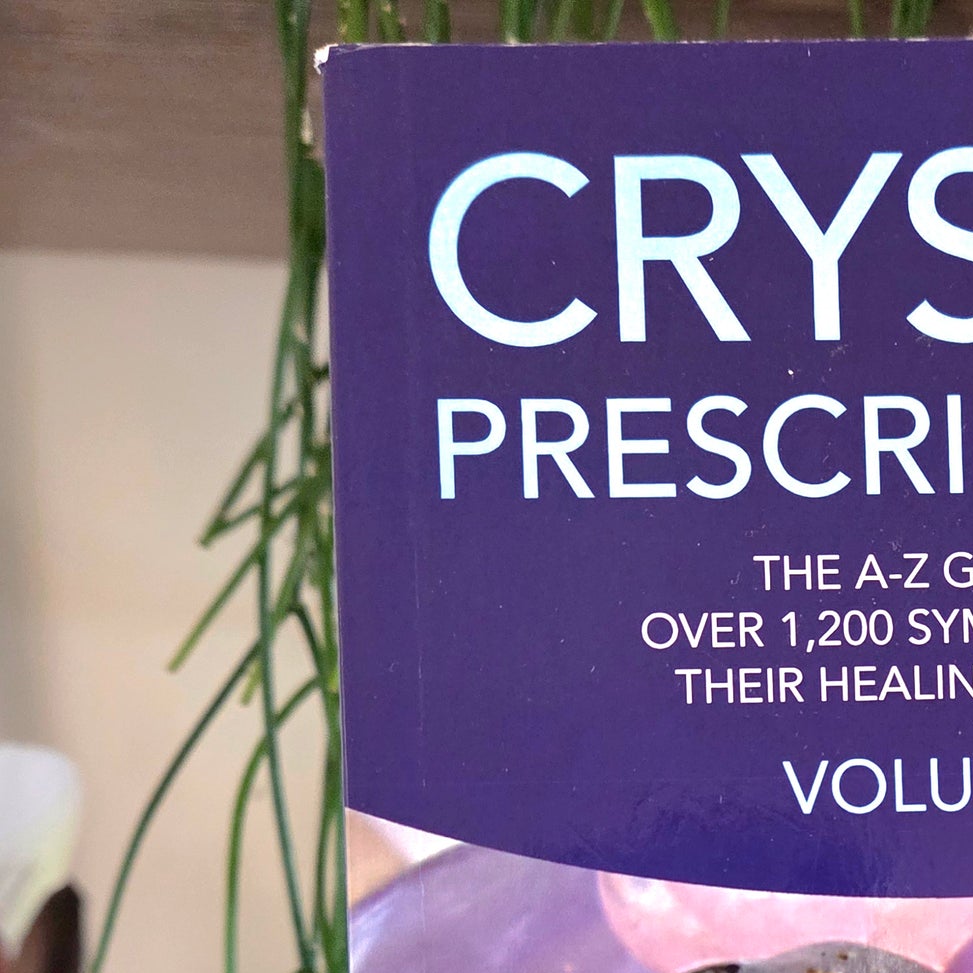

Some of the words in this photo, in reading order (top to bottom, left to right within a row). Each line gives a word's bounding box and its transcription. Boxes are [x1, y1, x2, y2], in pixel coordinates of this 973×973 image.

[752, 554, 842, 591] THE
[854, 552, 930, 590] A-Z
[641, 611, 765, 650] OVER
[781, 609, 894, 653] 1,200
[674, 667, 805, 705] THEIR
